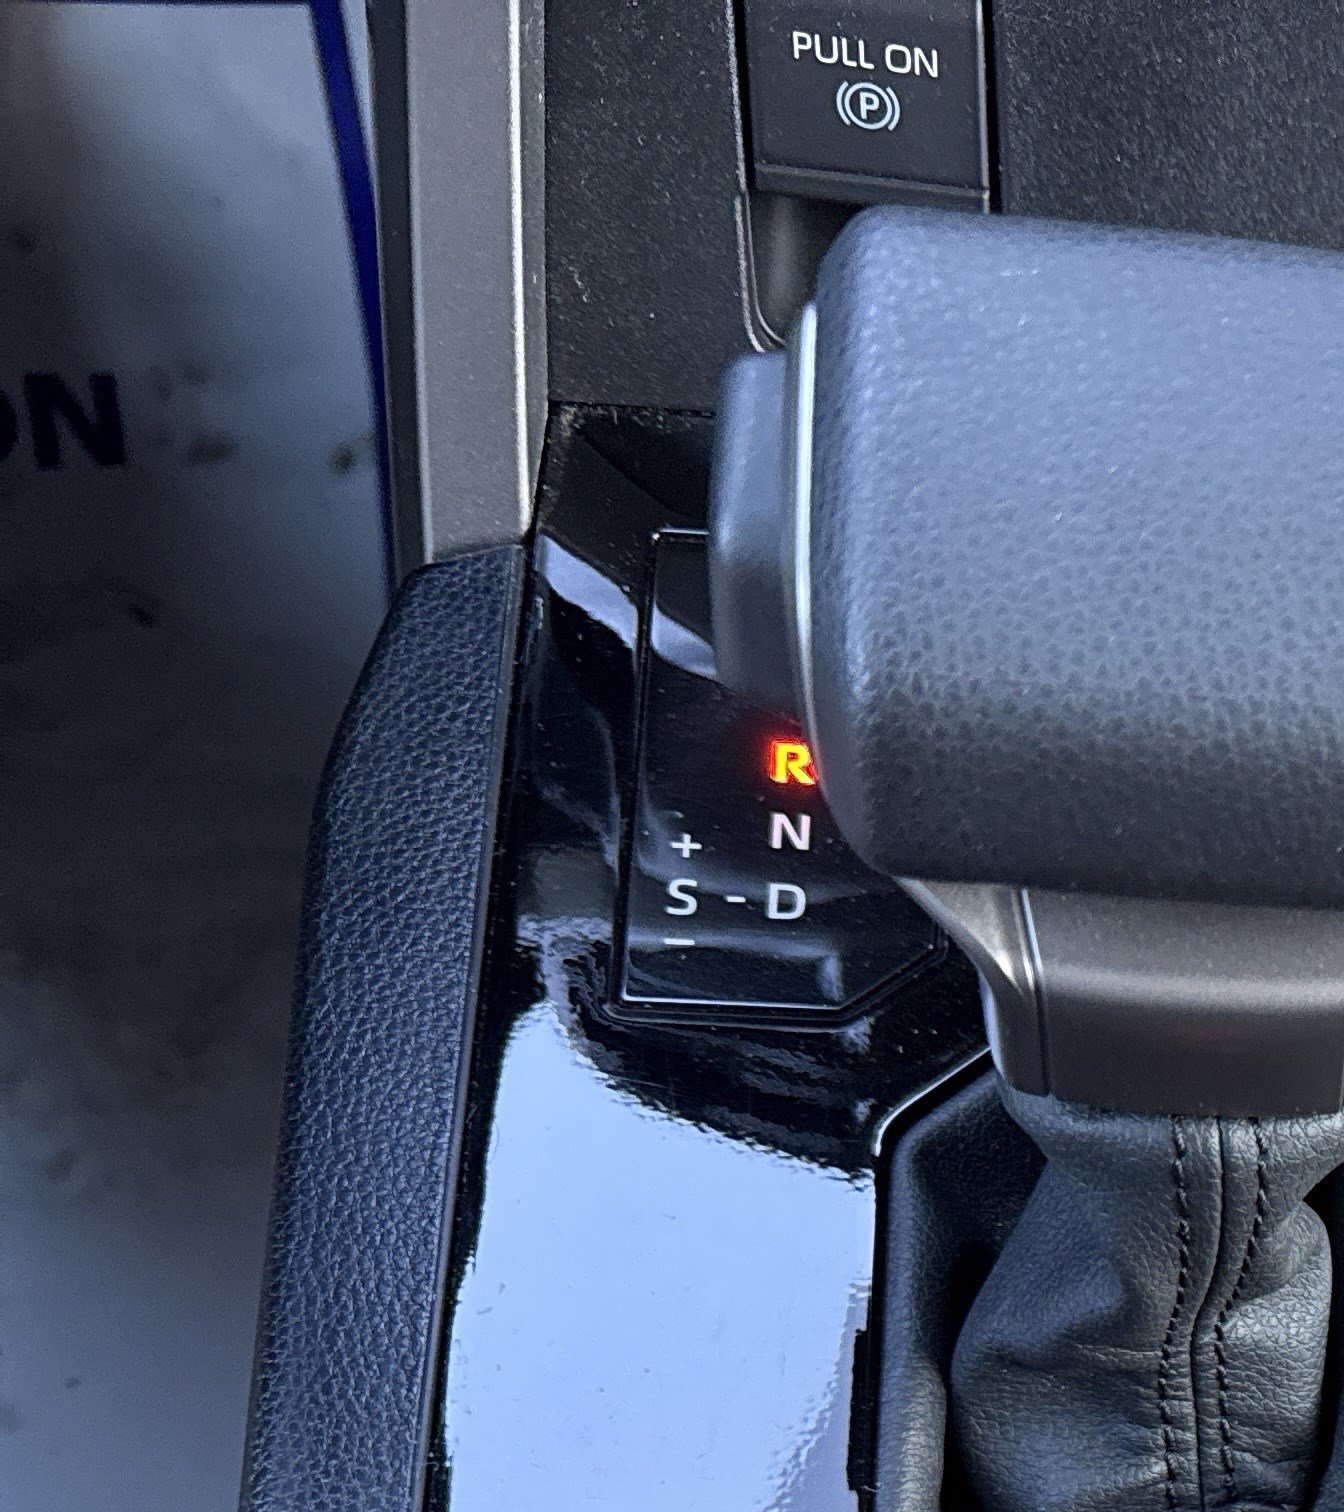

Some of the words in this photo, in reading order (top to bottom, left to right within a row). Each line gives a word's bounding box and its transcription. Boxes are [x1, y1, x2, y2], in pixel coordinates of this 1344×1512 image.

[792, 30, 875, 70] PULL
[885, 43, 938, 78] ON
[768, 739, 819, 786] R
[769, 812, 812, 851] N
[664, 878, 698, 916] S
[766, 883, 807, 920] D
